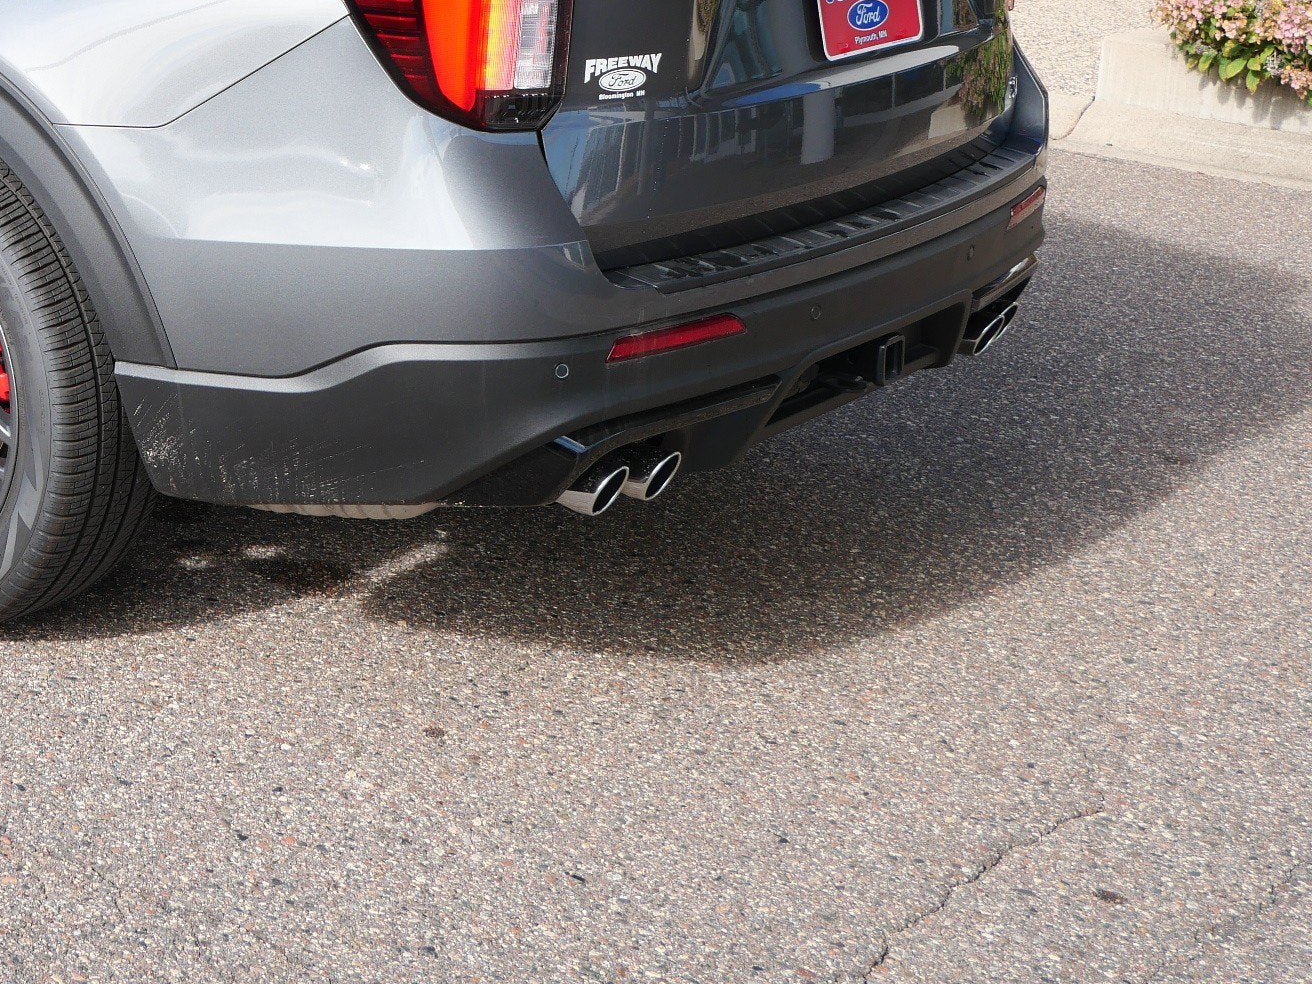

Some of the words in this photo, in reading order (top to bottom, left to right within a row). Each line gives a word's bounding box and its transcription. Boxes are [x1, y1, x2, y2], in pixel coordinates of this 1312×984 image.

[855, 3, 881, 26] Ford
[583, 52, 662, 84] FREEWAY
[608, 73, 637, 87] Ford
